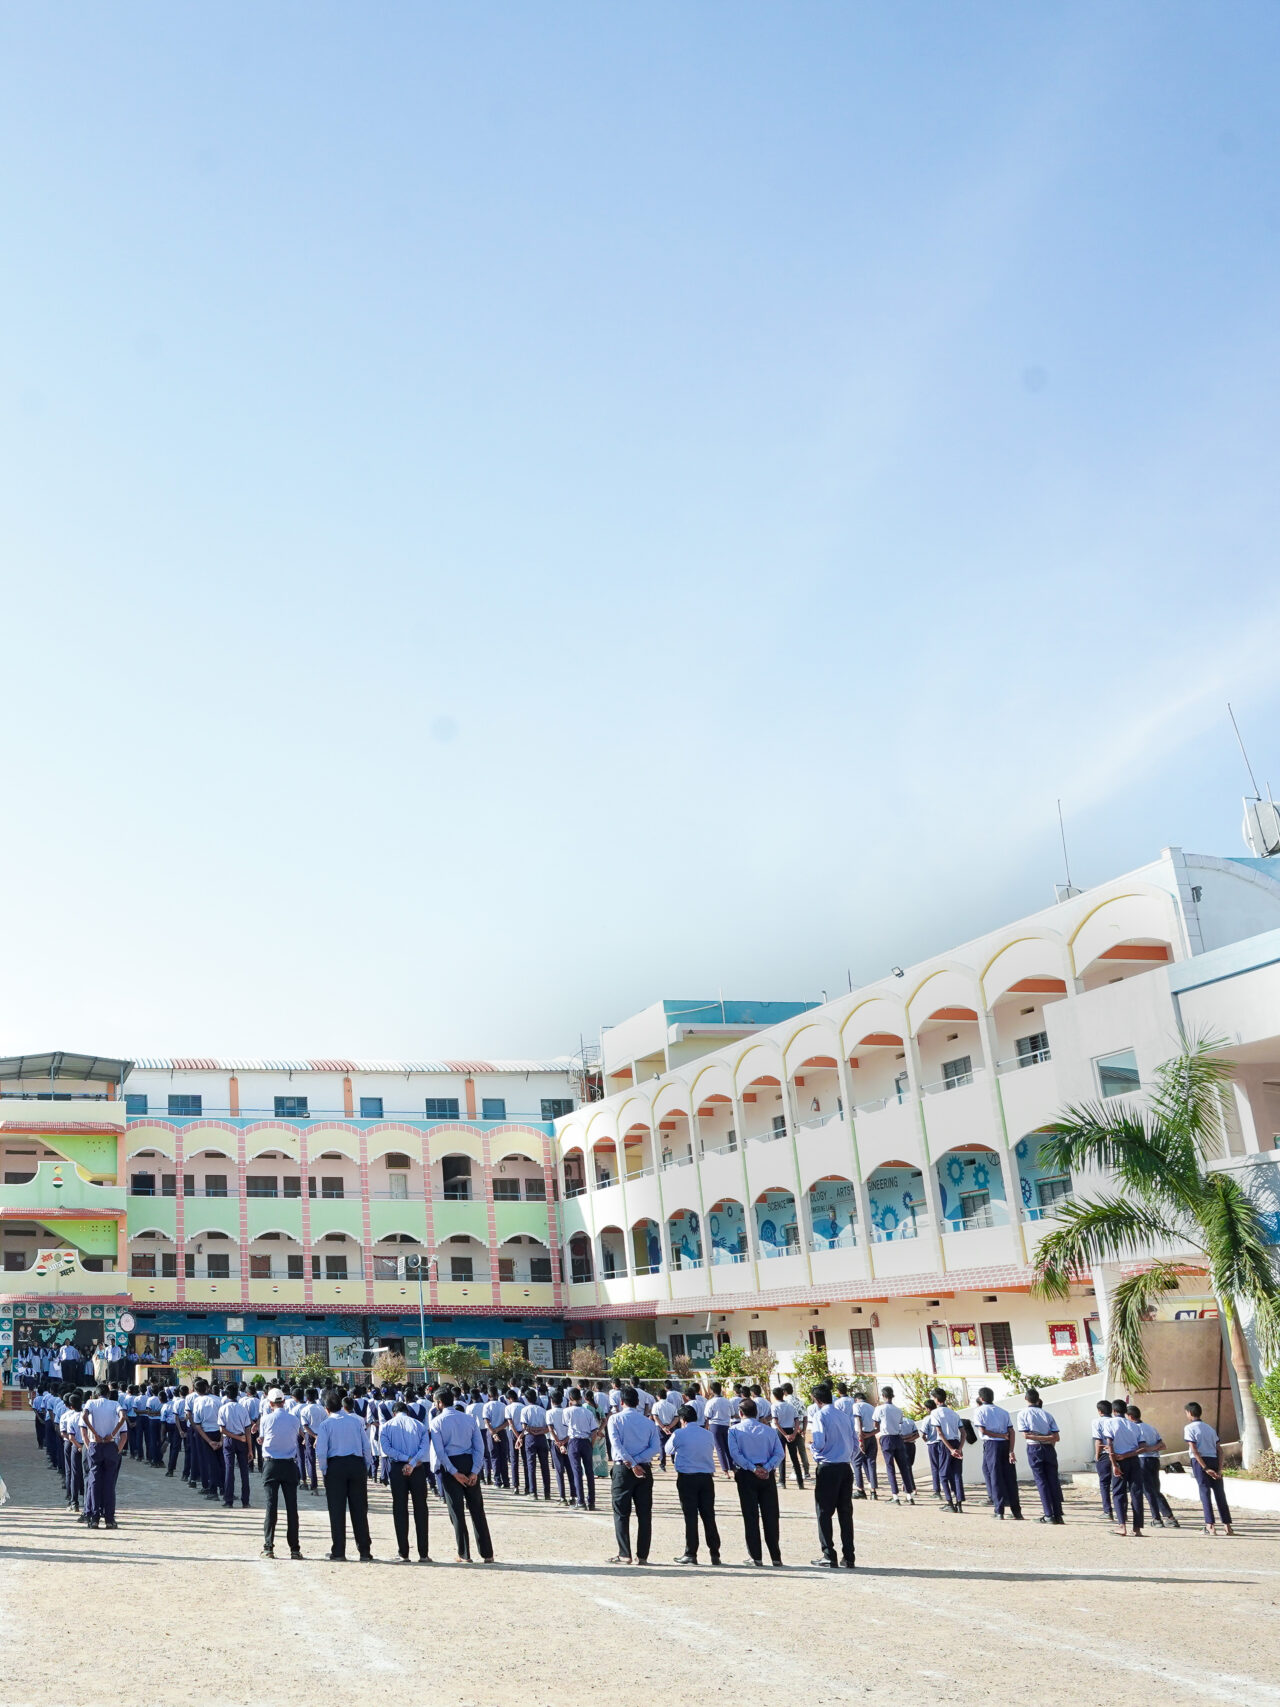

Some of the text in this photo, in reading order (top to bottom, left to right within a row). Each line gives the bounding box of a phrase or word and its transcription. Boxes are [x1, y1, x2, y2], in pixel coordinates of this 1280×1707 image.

[810, 1191, 827, 1203] OLOGY
[836, 1185, 851, 1199] ARTS
[867, 1176, 898, 1191] GINEERING
